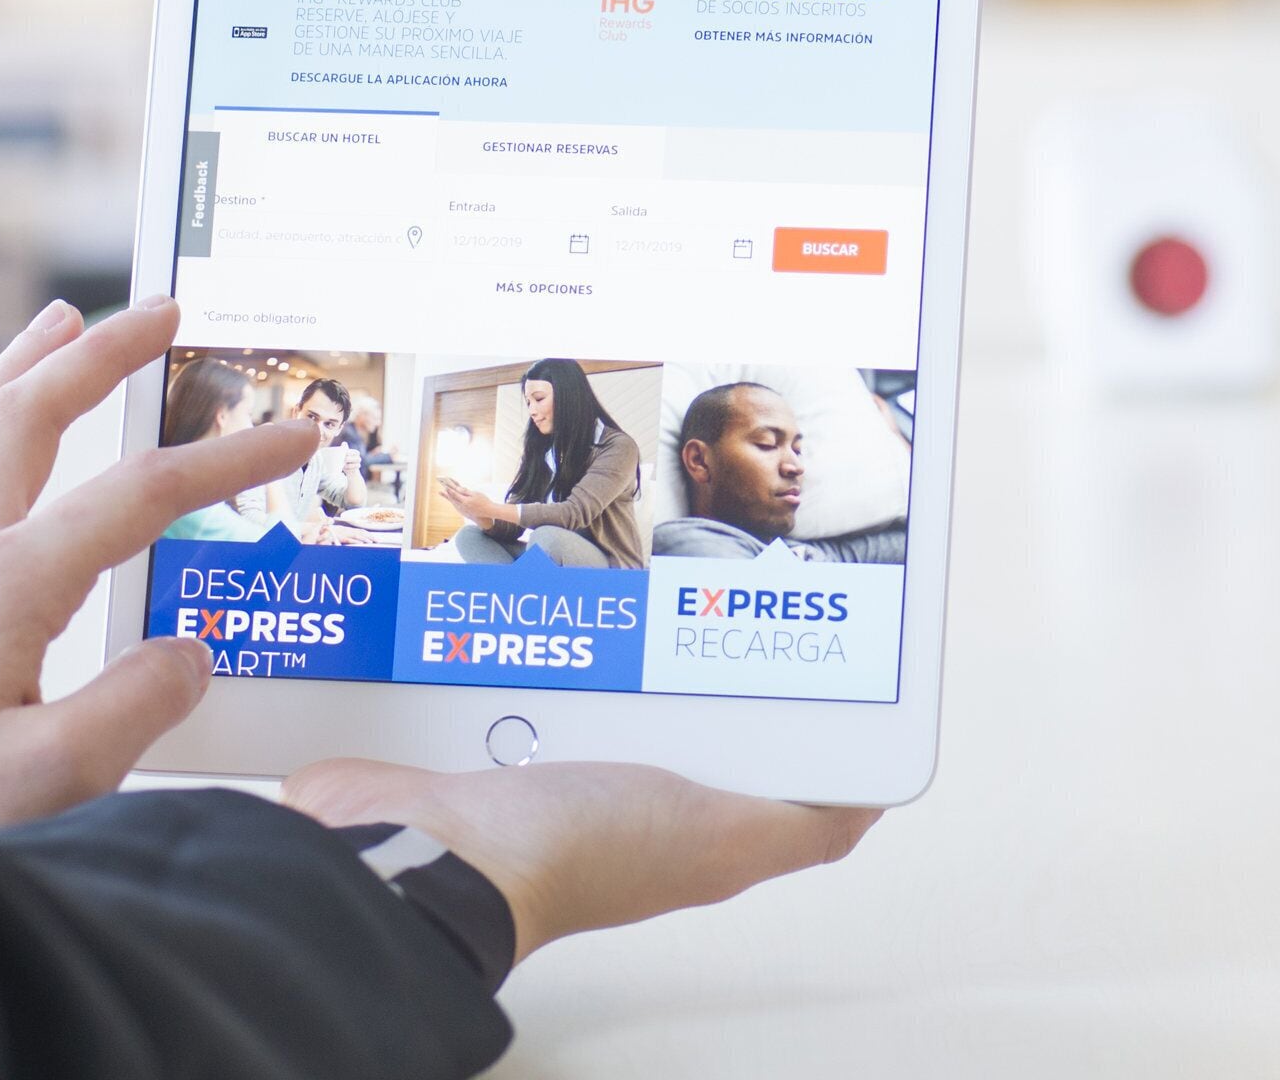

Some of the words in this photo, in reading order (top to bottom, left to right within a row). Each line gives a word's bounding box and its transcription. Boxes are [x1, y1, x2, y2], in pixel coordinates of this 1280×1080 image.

[296, 7, 367, 23] RESERVE,
[372, 7, 440, 24] ALÓJESE
[445, 9, 455, 24] Y
[696, 0, 716, 14] DE
[722, 1, 779, 16] SOCIOS
[785, 2, 866, 17] INSCRITOS
[599, 17, 652, 30] Rewards
[294, 25, 370, 40] GESTIONE
[375, 26, 395, 41] SU
[401, 24, 474, 42] PRÓXIMO
[480, 29, 523, 44] VIAJE
[598, 30, 628, 41] Club
[694, 30, 751, 42] OBTENER
[755, 29, 782, 43] MÁS
[786, 31, 873, 44] INFORMACIÓN
[293, 41, 313, 56] DE
[318, 42, 353, 57] UNA
[358, 43, 425, 58] MANERA
[431, 45, 508, 61] SENCILLA.
[290, 72, 363, 84] DESCARGUE
[367, 73, 383, 84] LA
[386, 72, 460, 86] APLICACIÓN
[464, 75, 508, 87] AHORA
[268, 131, 317, 143] BUSCAR
[321, 132, 339, 143] UN
[342, 133, 381, 144] HOTEL
[482, 142, 552, 153] GESTIONAR
[556, 143, 619, 155] RESERVAS
[191, 160, 209, 228] Feedback
[214, 194, 257, 206] Destino
[448, 201, 496, 213] Entrada
[611, 205, 648, 217] Salida
[337, 230, 392, 244] atracción
[452, 235, 523, 248] 12/10/2019
[615, 239, 683, 253] 12/11/2019
[802, 241, 858, 256] BUSCAR
[496, 281, 523, 293] MÁS
[529, 283, 593, 295] OPCIONES
[254, 311, 317, 325] obligatorio
[180, 567, 373, 606] DESAYUNO
[426, 590, 638, 629] ESENCIALES
[677, 586, 848, 622] EXPRESS
[176, 607, 345, 645] EXPRESS
[422, 630, 593, 668] EXPRESS
[675, 626, 847, 663] RECARGA
[210, 649, 307, 677] ART™
